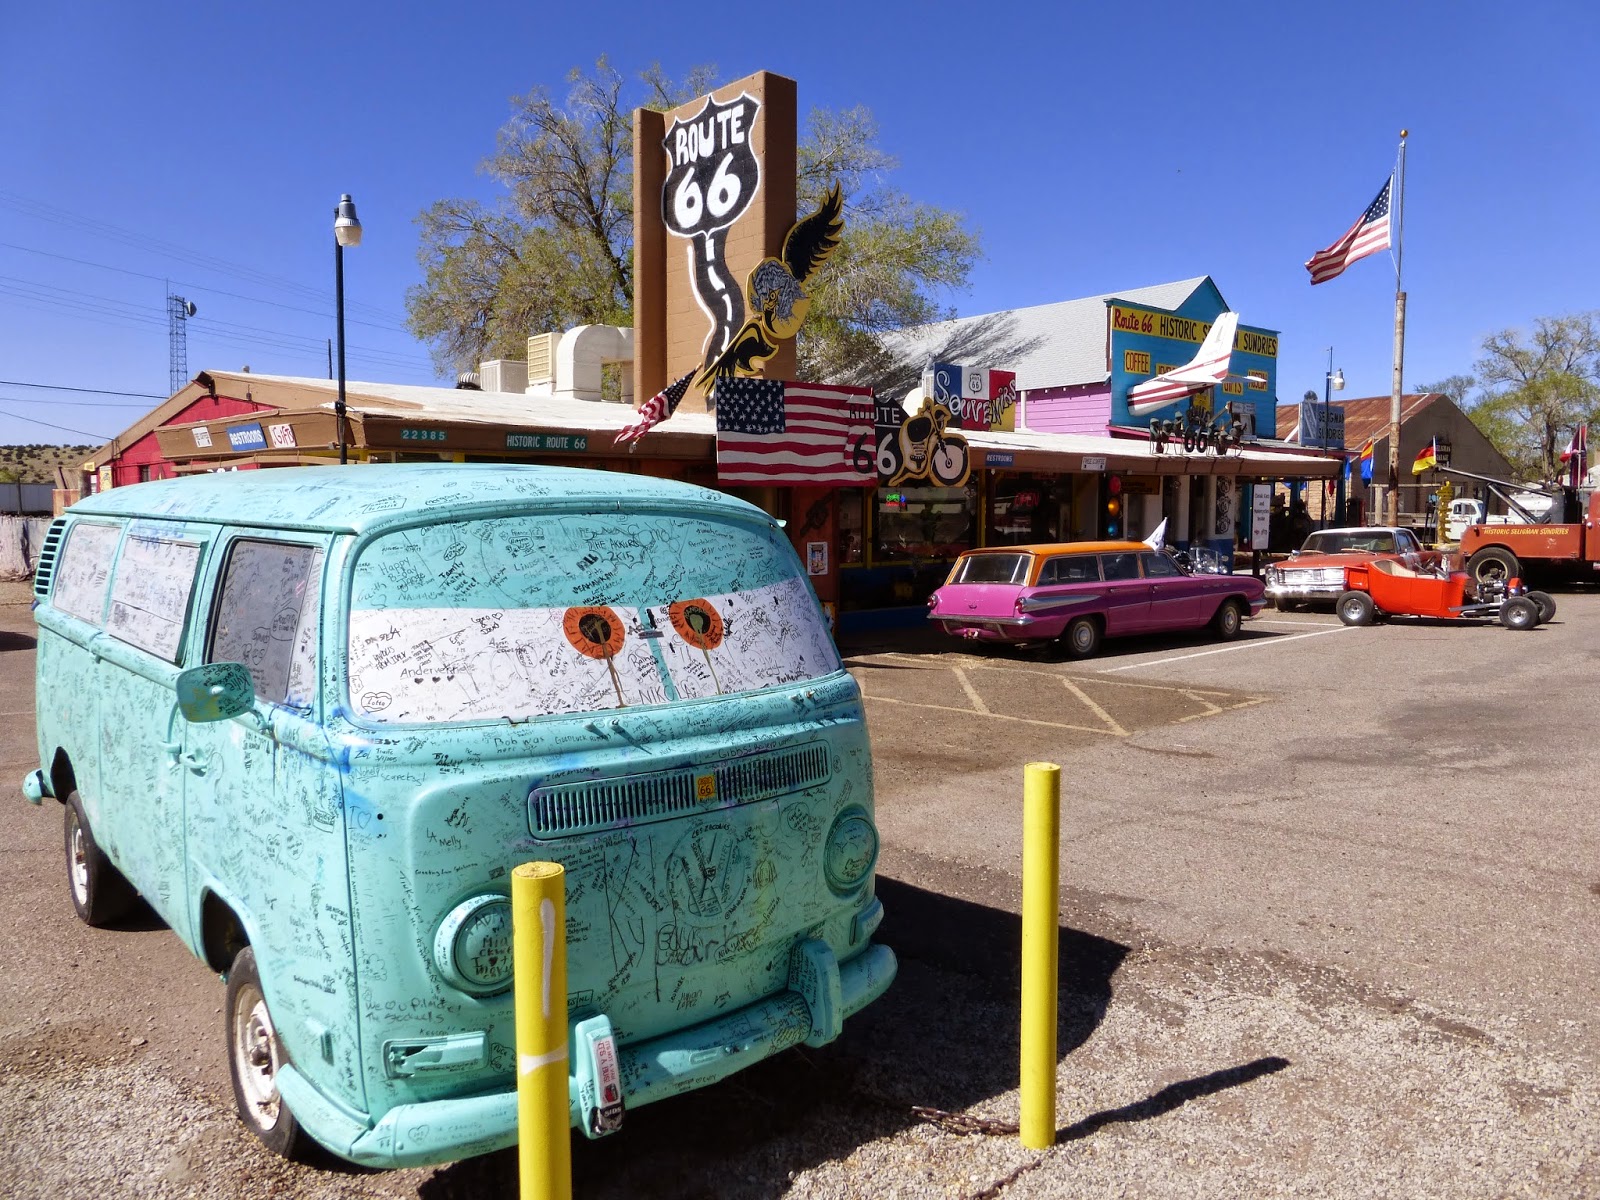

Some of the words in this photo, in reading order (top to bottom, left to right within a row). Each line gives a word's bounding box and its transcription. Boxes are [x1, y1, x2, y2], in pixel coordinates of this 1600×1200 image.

[675, 104, 745, 166] ROUTE
[674, 152, 742, 229] 66
[1114, 308, 1139, 331] Route
[1141, 313, 1154, 333] 66
[1160, 315, 1197, 341] HISTORIC
[1243, 332, 1277, 356] SUNDRIES
[1125, 352, 1149, 373] COFFEE
[971, 381, 980, 389] 66
[1318, 410, 1345, 424] SEIGMAN
[229, 429, 264, 446] RESTROOMS
[402, 429, 446, 441] 22385
[1318, 427, 1345, 440] SUDRIES
[506, 435, 540, 448] HISTORIC
[546, 436, 569, 449] ROUTE
[573, 437, 586, 450] 66
[853, 432, 897, 475] 66
[986, 454, 1013, 462] RESTROOMS
[1510, 527, 1539, 535] SELIGMAN
[1539, 527, 1569, 535] SUNDRIES
[378, 557, 411, 575] Happy
[700, 786, 711, 795] 66
